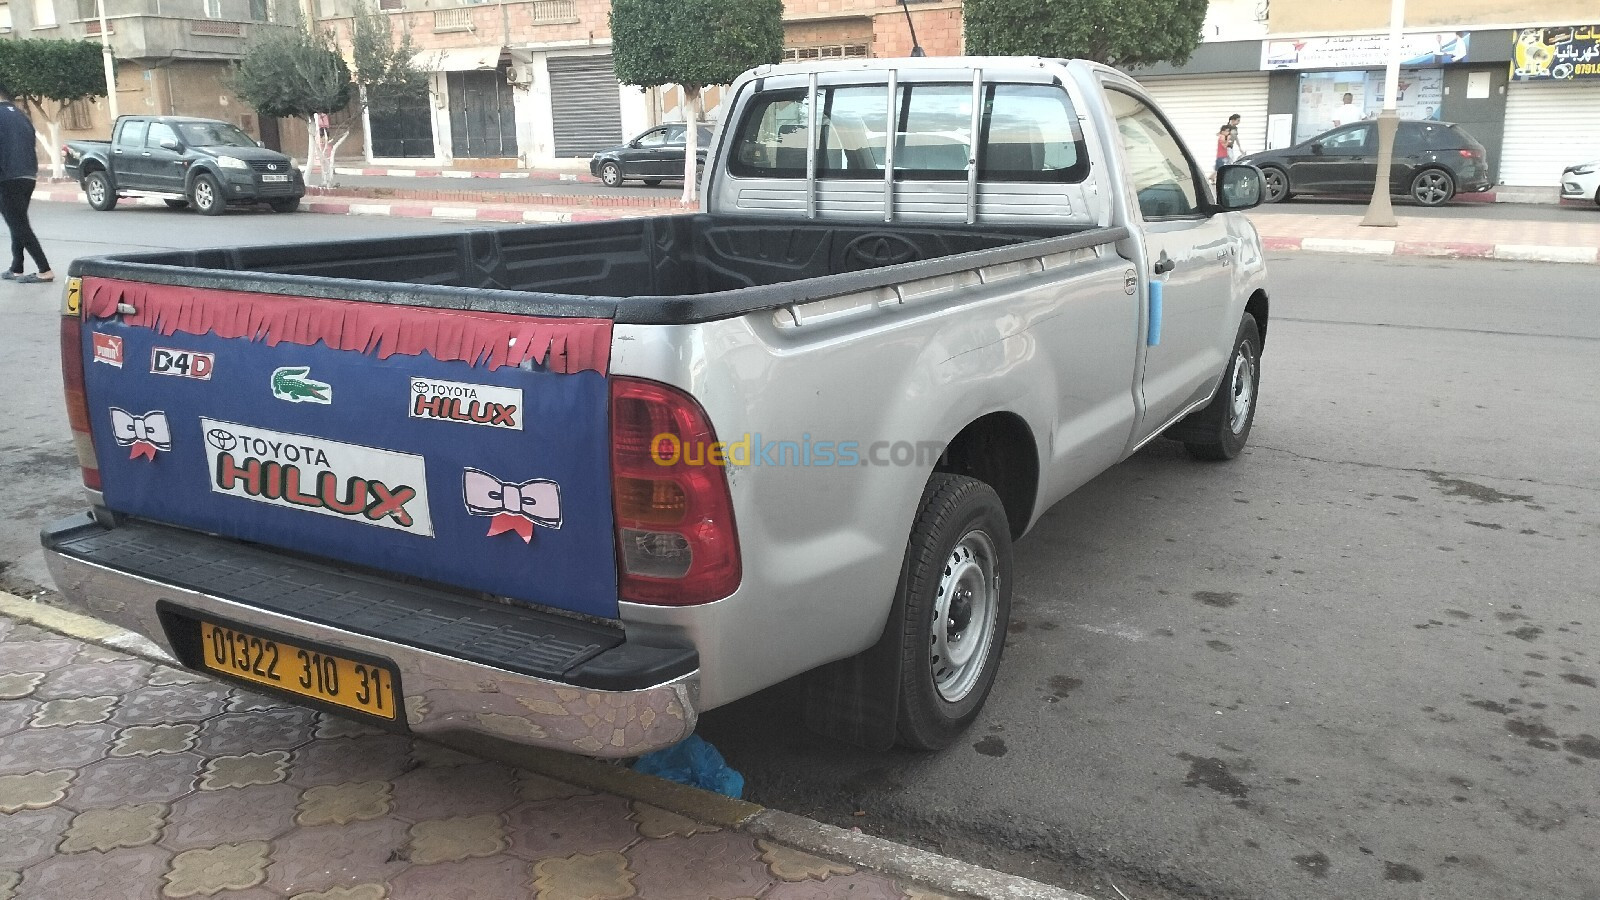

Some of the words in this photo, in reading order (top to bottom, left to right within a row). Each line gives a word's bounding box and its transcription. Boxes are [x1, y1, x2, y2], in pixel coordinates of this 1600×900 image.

[96, 345, 116, 360] PUMA
[430, 384, 477, 398] TOYOTA
[414, 394, 517, 427] HILUX
[238, 435, 331, 468] TOYOTA
[215, 451, 416, 528] HILUX
[212, 626, 281, 681] 01322
[297, 650, 339, 697] 310
[354, 664, 383, 710] 31
